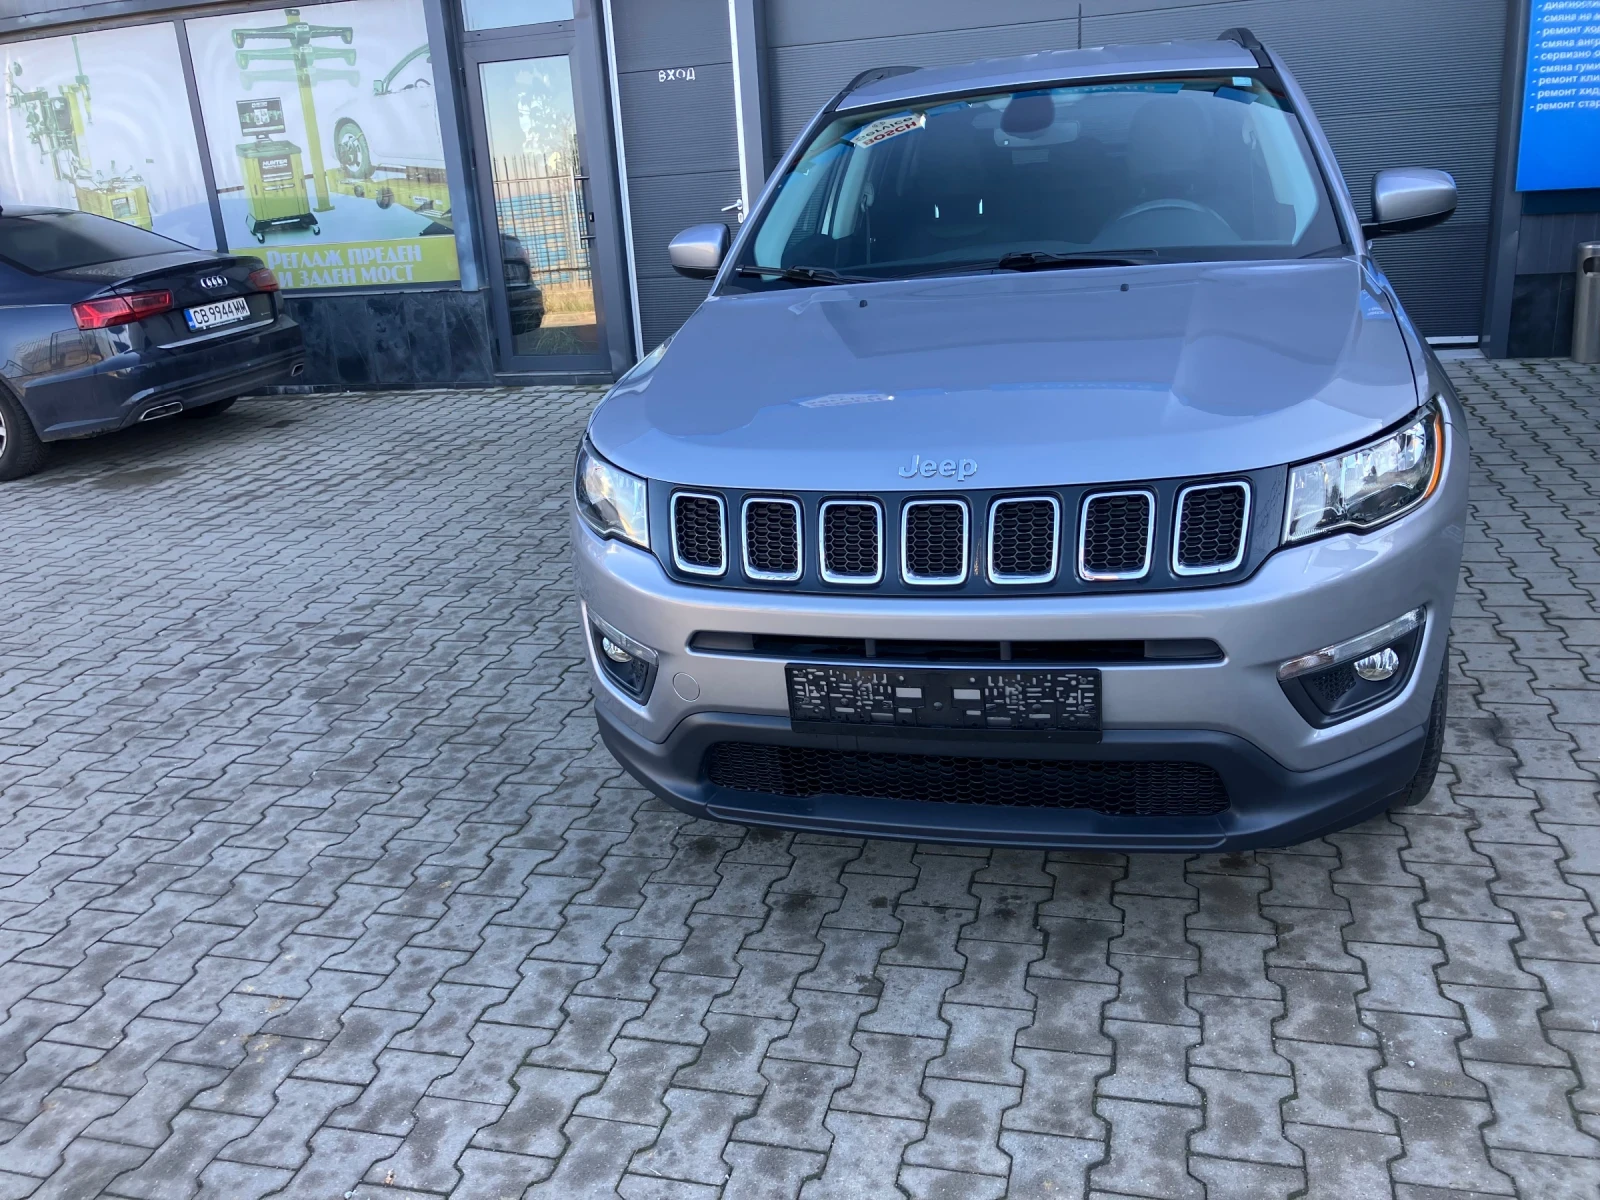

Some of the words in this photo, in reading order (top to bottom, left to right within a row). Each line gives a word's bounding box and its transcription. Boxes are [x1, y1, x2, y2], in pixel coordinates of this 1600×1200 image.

[1543, 13, 1577, 22] смяна
[1542, 26, 1582, 37] ремонт
[1541, 39, 1575, 48] смяна
[1540, 50, 1591, 61] сервизно
[1540, 63, 1573, 73] смяна
[658, 67, 696, 83] ВХОД
[1538, 75, 1578, 86] ремонт
[1537, 88, 1577, 99] ремонт
[1536, 101, 1575, 112] ремонт
[266, 249, 344, 270] РЕГЛАЖ
[347, 244, 422, 265] ПРЕДЕН
[278, 271, 294, 288] И
[300, 266, 357, 287] ЗАДЕН
[360, 264, 414, 284] МОСТ
[208, 302, 234, 321] 9944
[898, 454, 978, 482] Jeep
